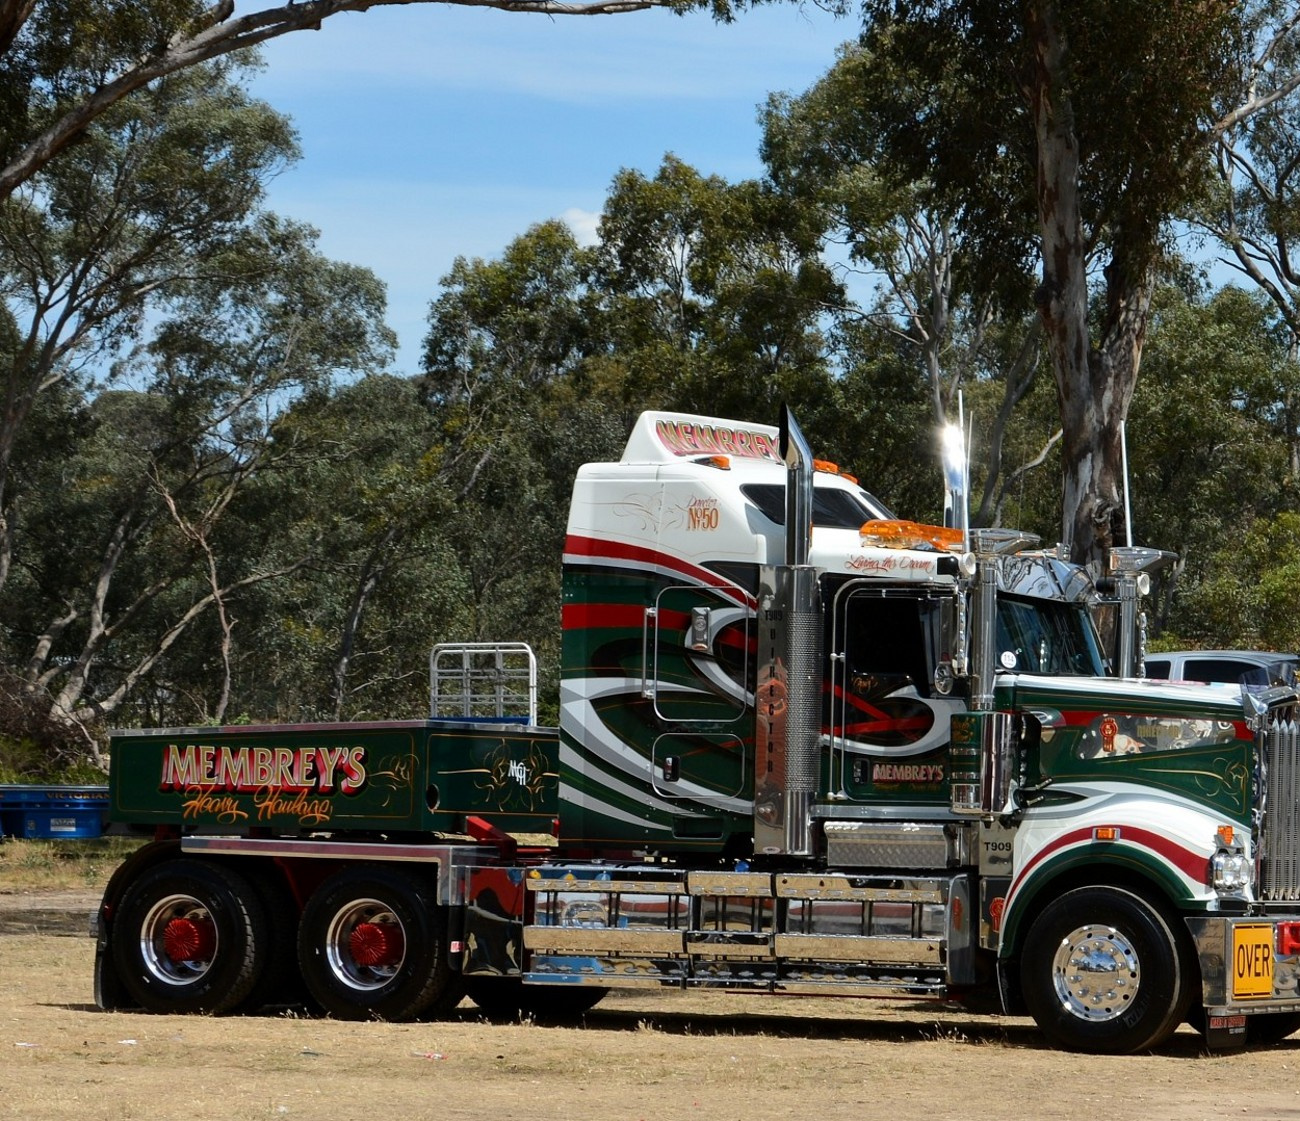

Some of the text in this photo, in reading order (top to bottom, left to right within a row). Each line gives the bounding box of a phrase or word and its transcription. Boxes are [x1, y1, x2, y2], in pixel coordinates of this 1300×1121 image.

[160, 744, 369, 794] MEMBREY'S
[873, 763, 944, 782] MEMBREY'S
[182, 785, 333, 826] Heavy Haulage
[984, 841, 1012, 852] T909
[1237, 944, 1270, 978] OVER
